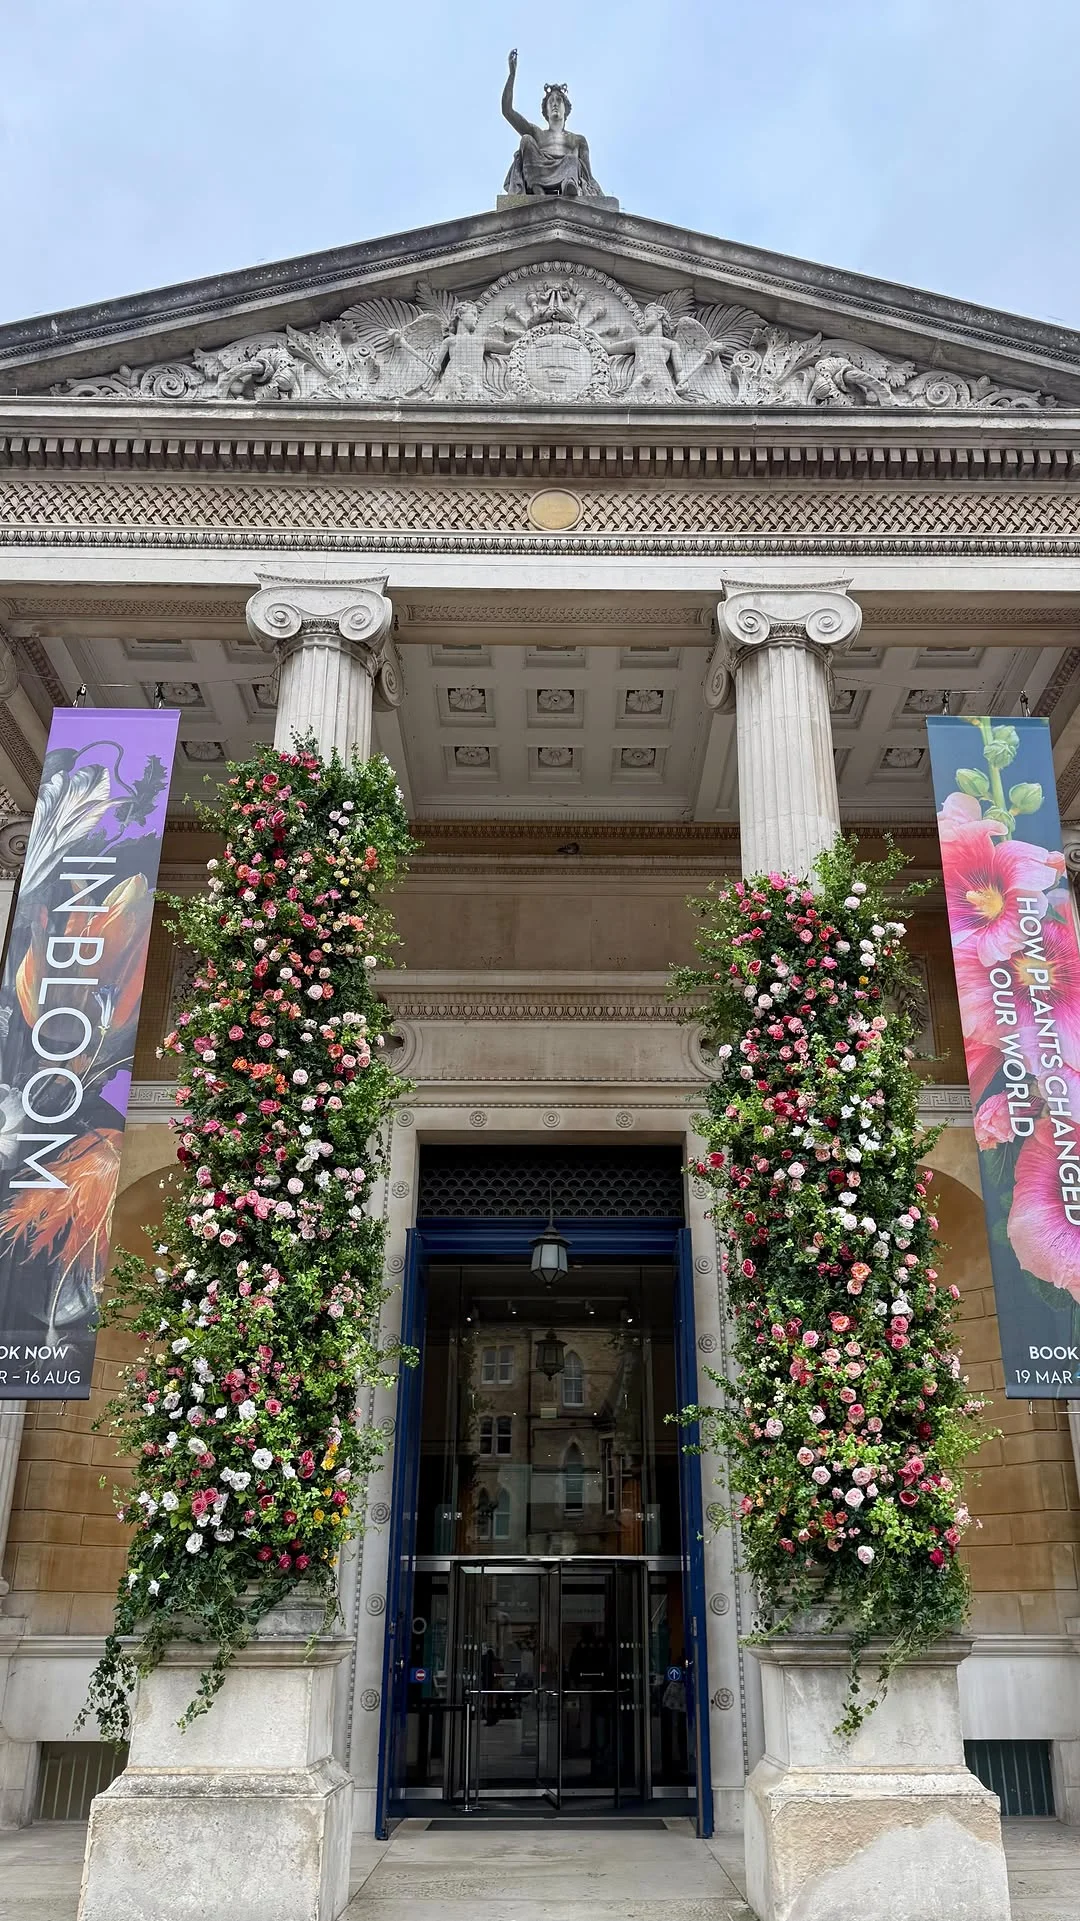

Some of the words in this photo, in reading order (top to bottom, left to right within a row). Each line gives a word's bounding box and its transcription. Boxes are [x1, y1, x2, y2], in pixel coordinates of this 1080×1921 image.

[52, 856, 117, 913] IN
[1016, 897, 1047, 962] HOW
[989, 967, 1018, 1026] OUR
[1026, 968, 1064, 1069] PLANTS
[9, 936, 105, 1189] BLOOM
[999, 1033, 1035, 1137] WORLD
[1044, 1075, 1080, 1226] CHANGED
[24, 1346, 69, 1360] NOW
[25, 1370, 40, 1384] 16
[43, 1370, 81, 1384] AUG
[1015, 1369, 1031, 1384] 19
[1035, 1370, 1073, 1384] MAR
[1029, 1346, 1080, 1360] BOOK
